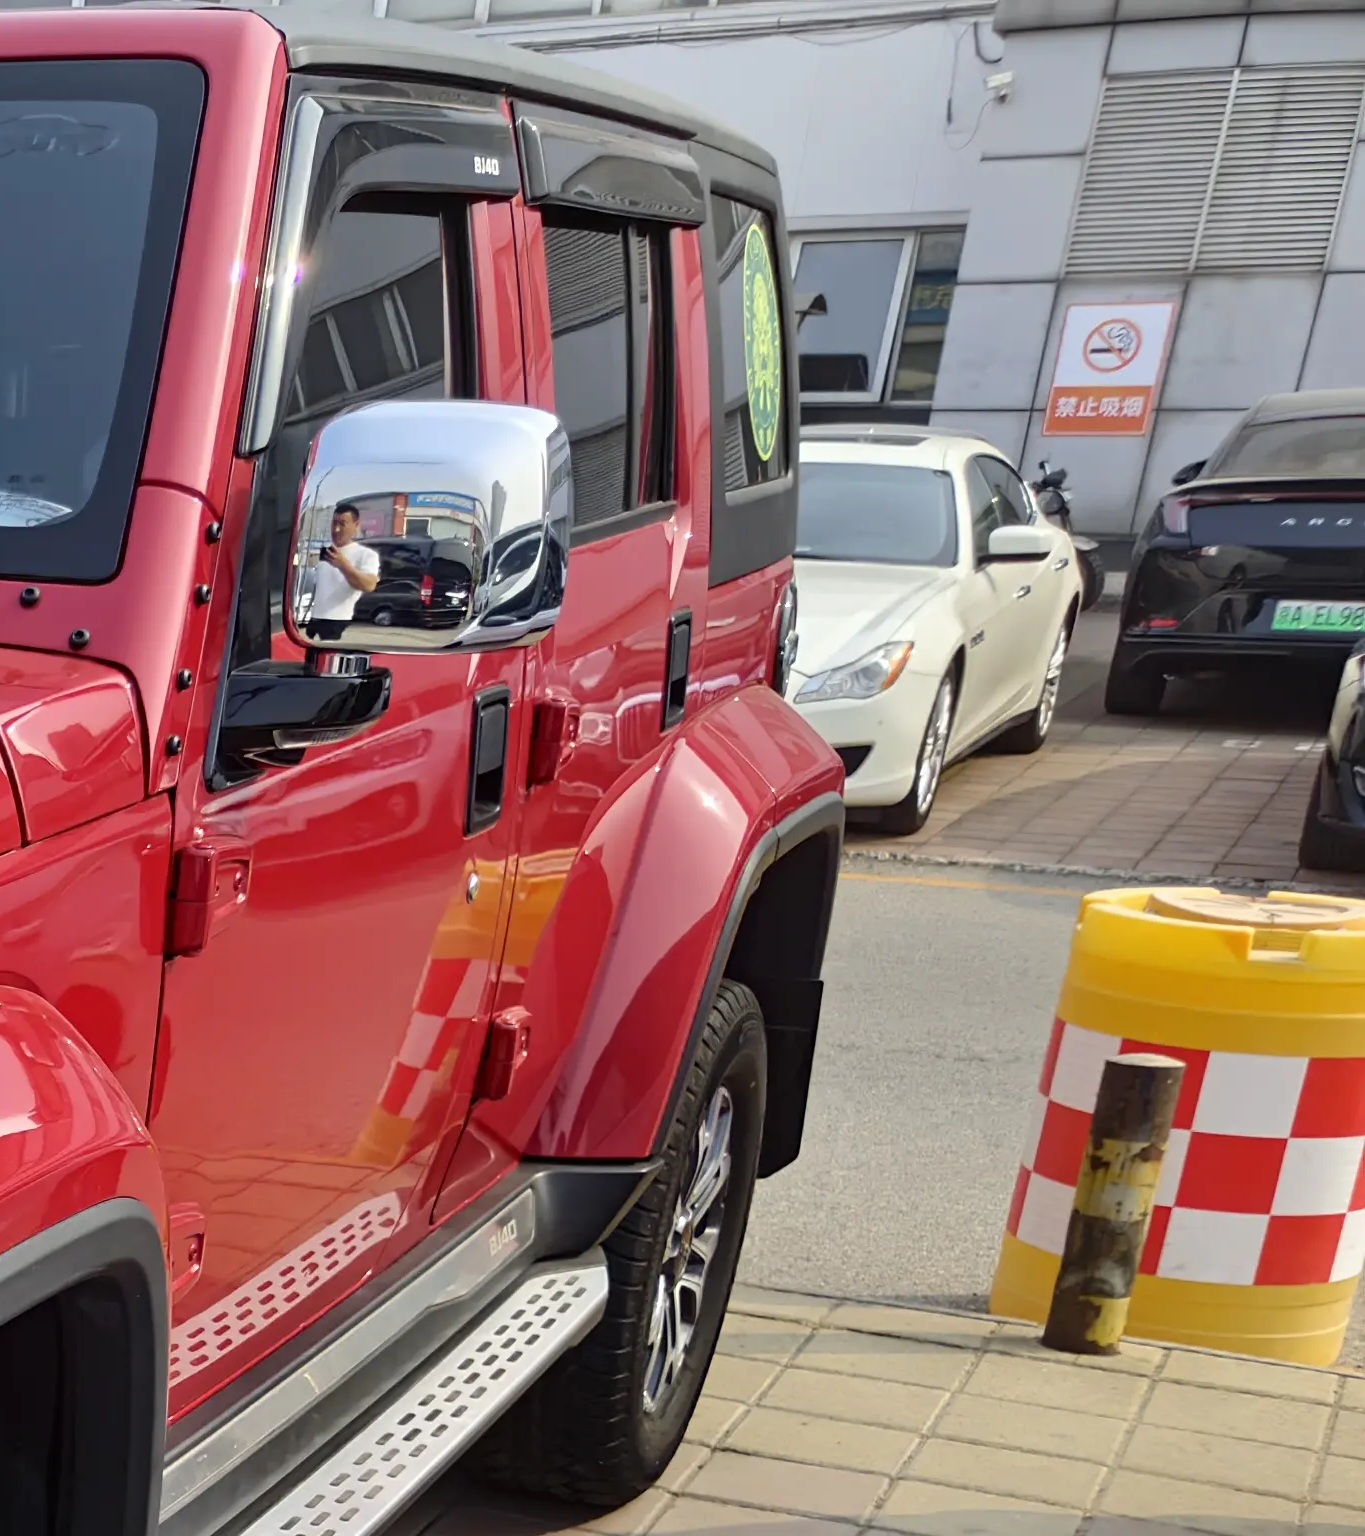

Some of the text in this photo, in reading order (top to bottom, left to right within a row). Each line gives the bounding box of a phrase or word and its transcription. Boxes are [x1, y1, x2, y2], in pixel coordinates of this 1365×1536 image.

[1054, 396, 1146, 418] 禁止吸烟
[489, 1218, 518, 1257] BJ40
